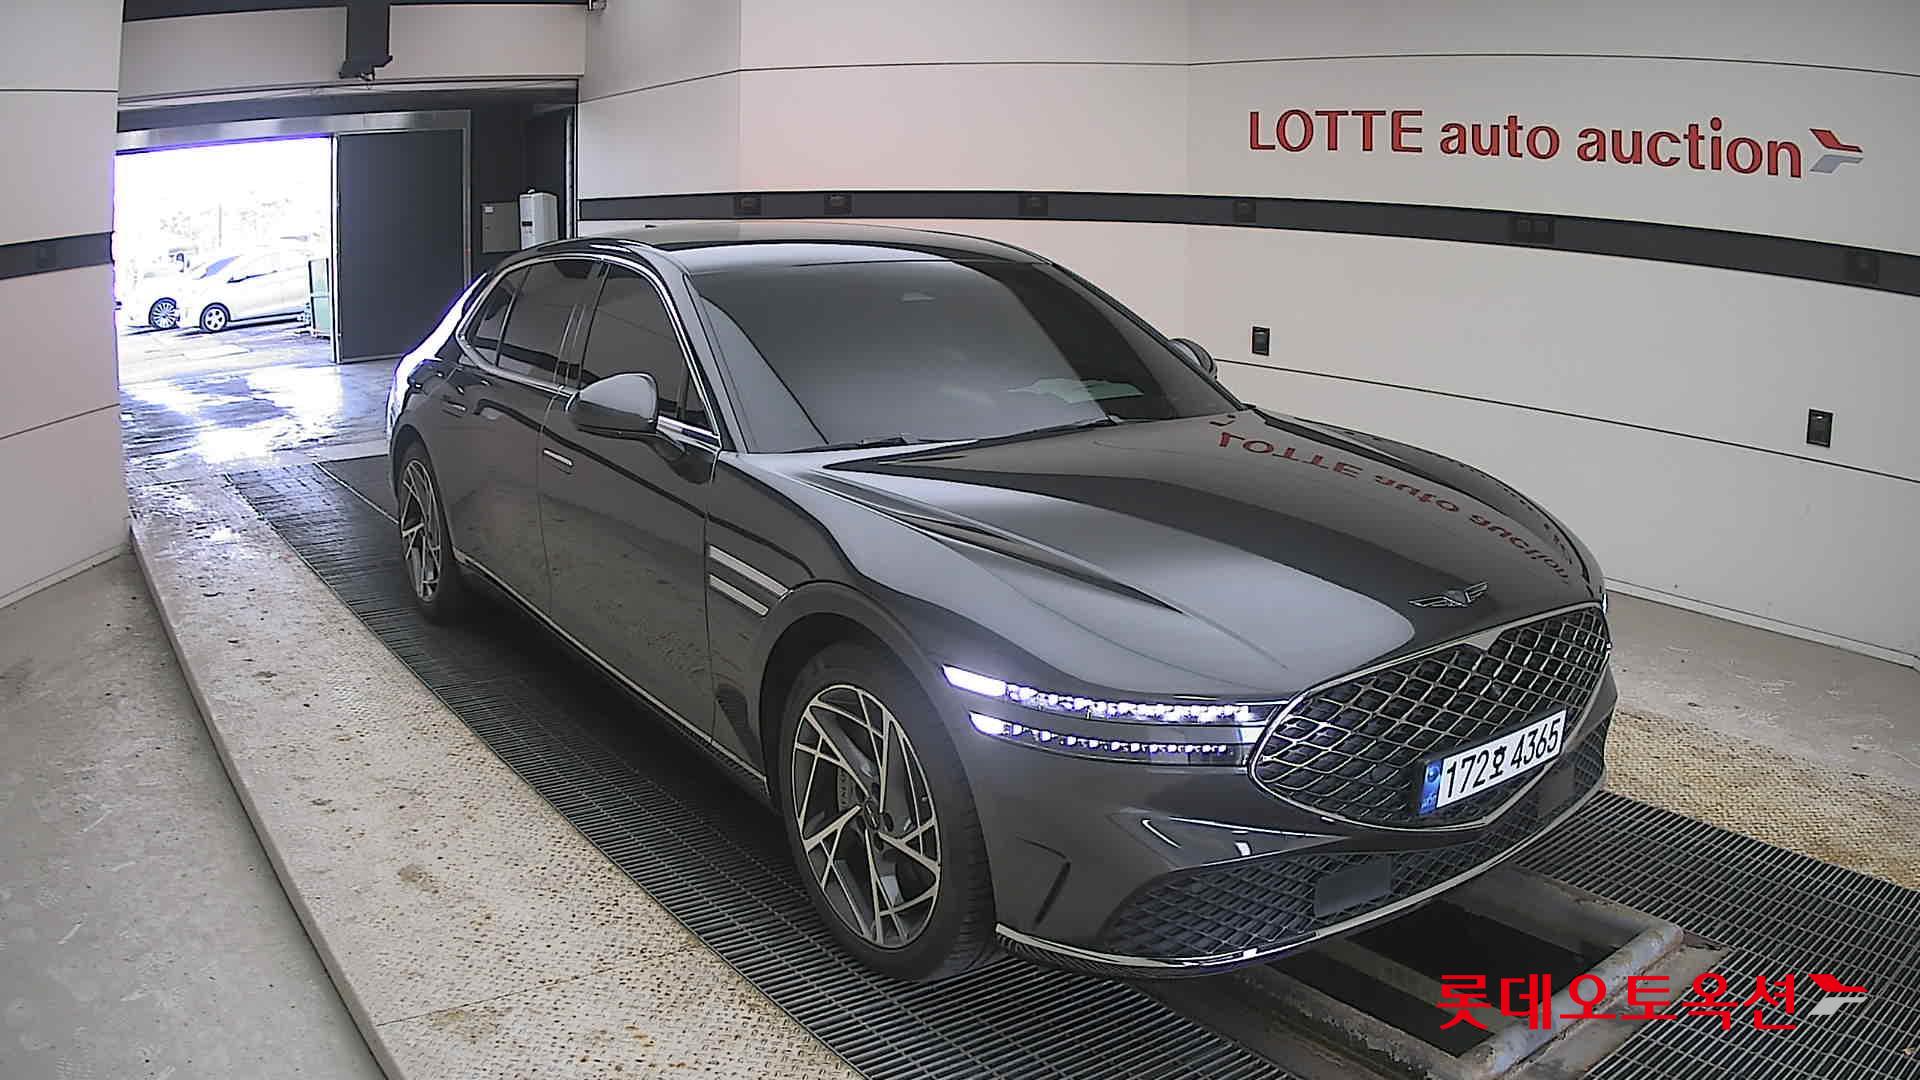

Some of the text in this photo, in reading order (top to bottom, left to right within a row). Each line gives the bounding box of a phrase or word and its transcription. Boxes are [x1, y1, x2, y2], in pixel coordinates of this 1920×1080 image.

[1248, 109, 1802, 179] LOTTE auto auction
[1446, 718, 1561, 798] 172호 4365
